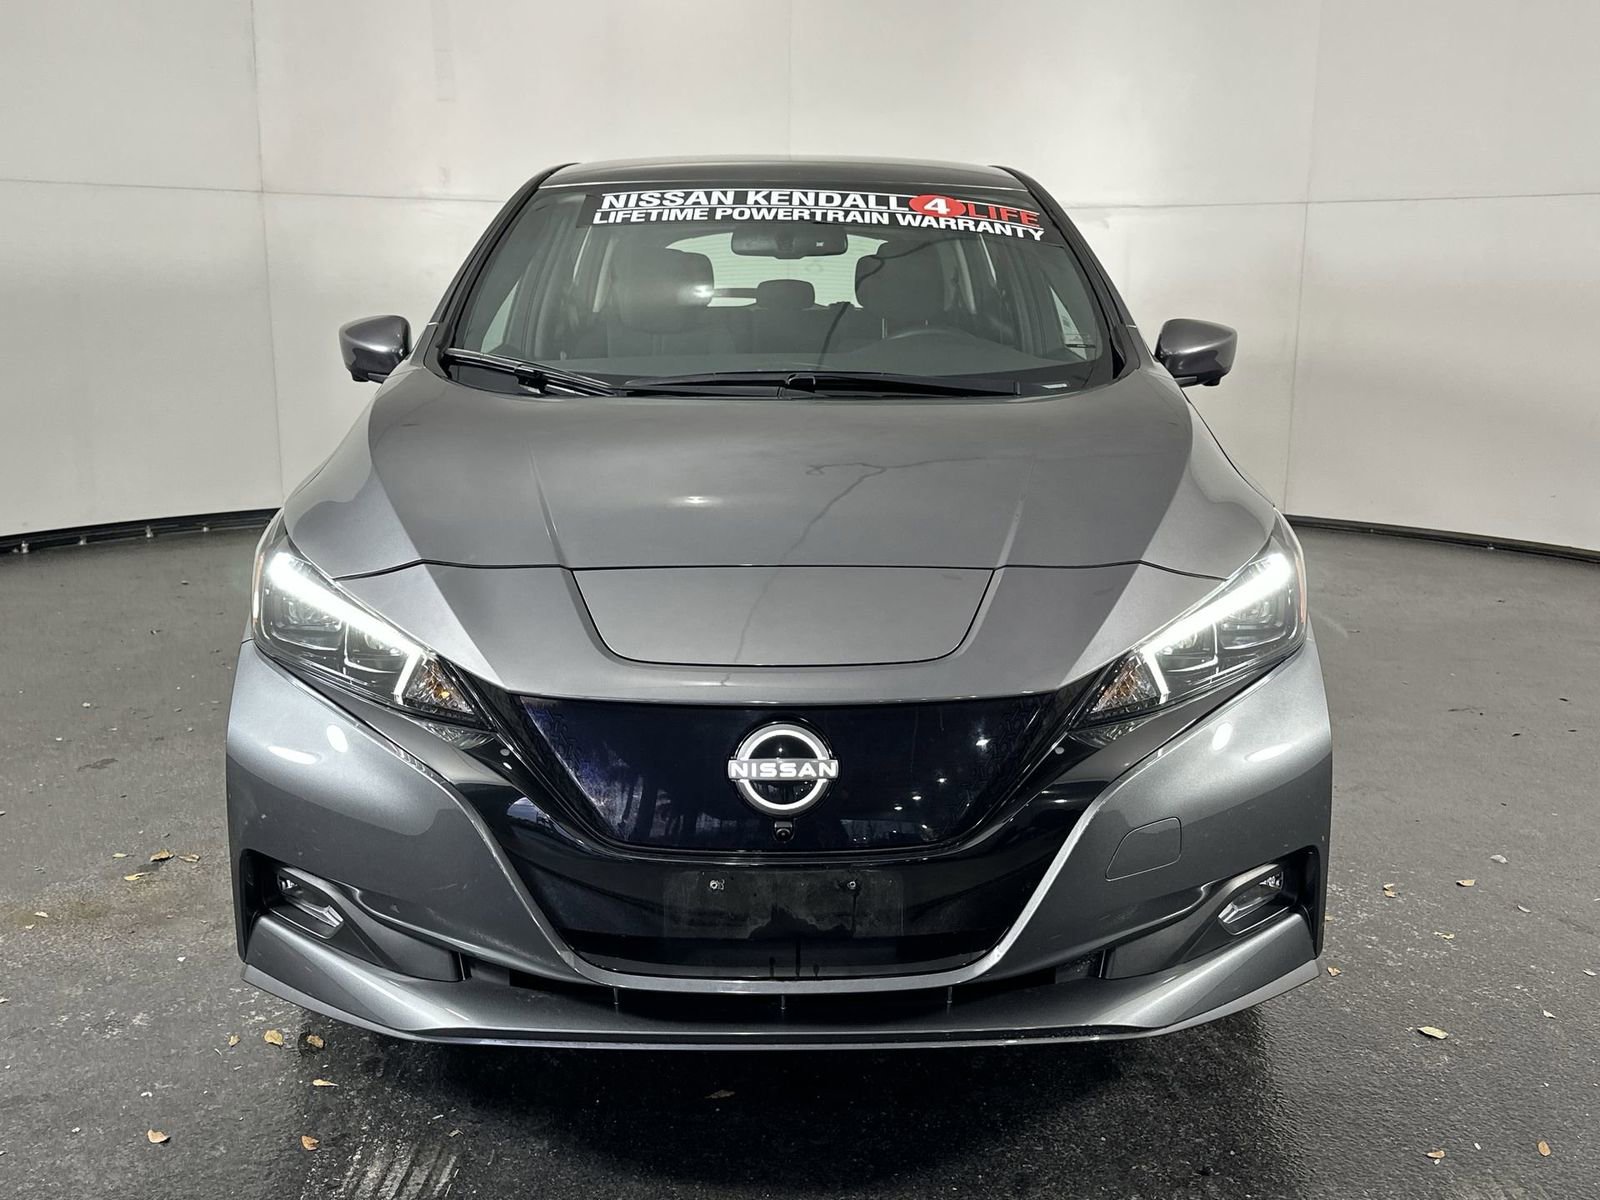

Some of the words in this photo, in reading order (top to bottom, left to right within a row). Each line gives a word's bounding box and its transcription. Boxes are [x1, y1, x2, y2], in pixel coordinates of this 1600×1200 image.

[592, 207, 708, 224] LIFETIME
[714, 207, 889, 224] POWERTRAIN
[896, 214, 1045, 241] WARRANTY
[601, 191, 735, 209] NISSAN
[746, 191, 909, 211] KENDALL
[923, 198, 950, 215] 4
[967, 204, 1039, 226] LIFE
[730, 762, 837, 777] NISSAN
